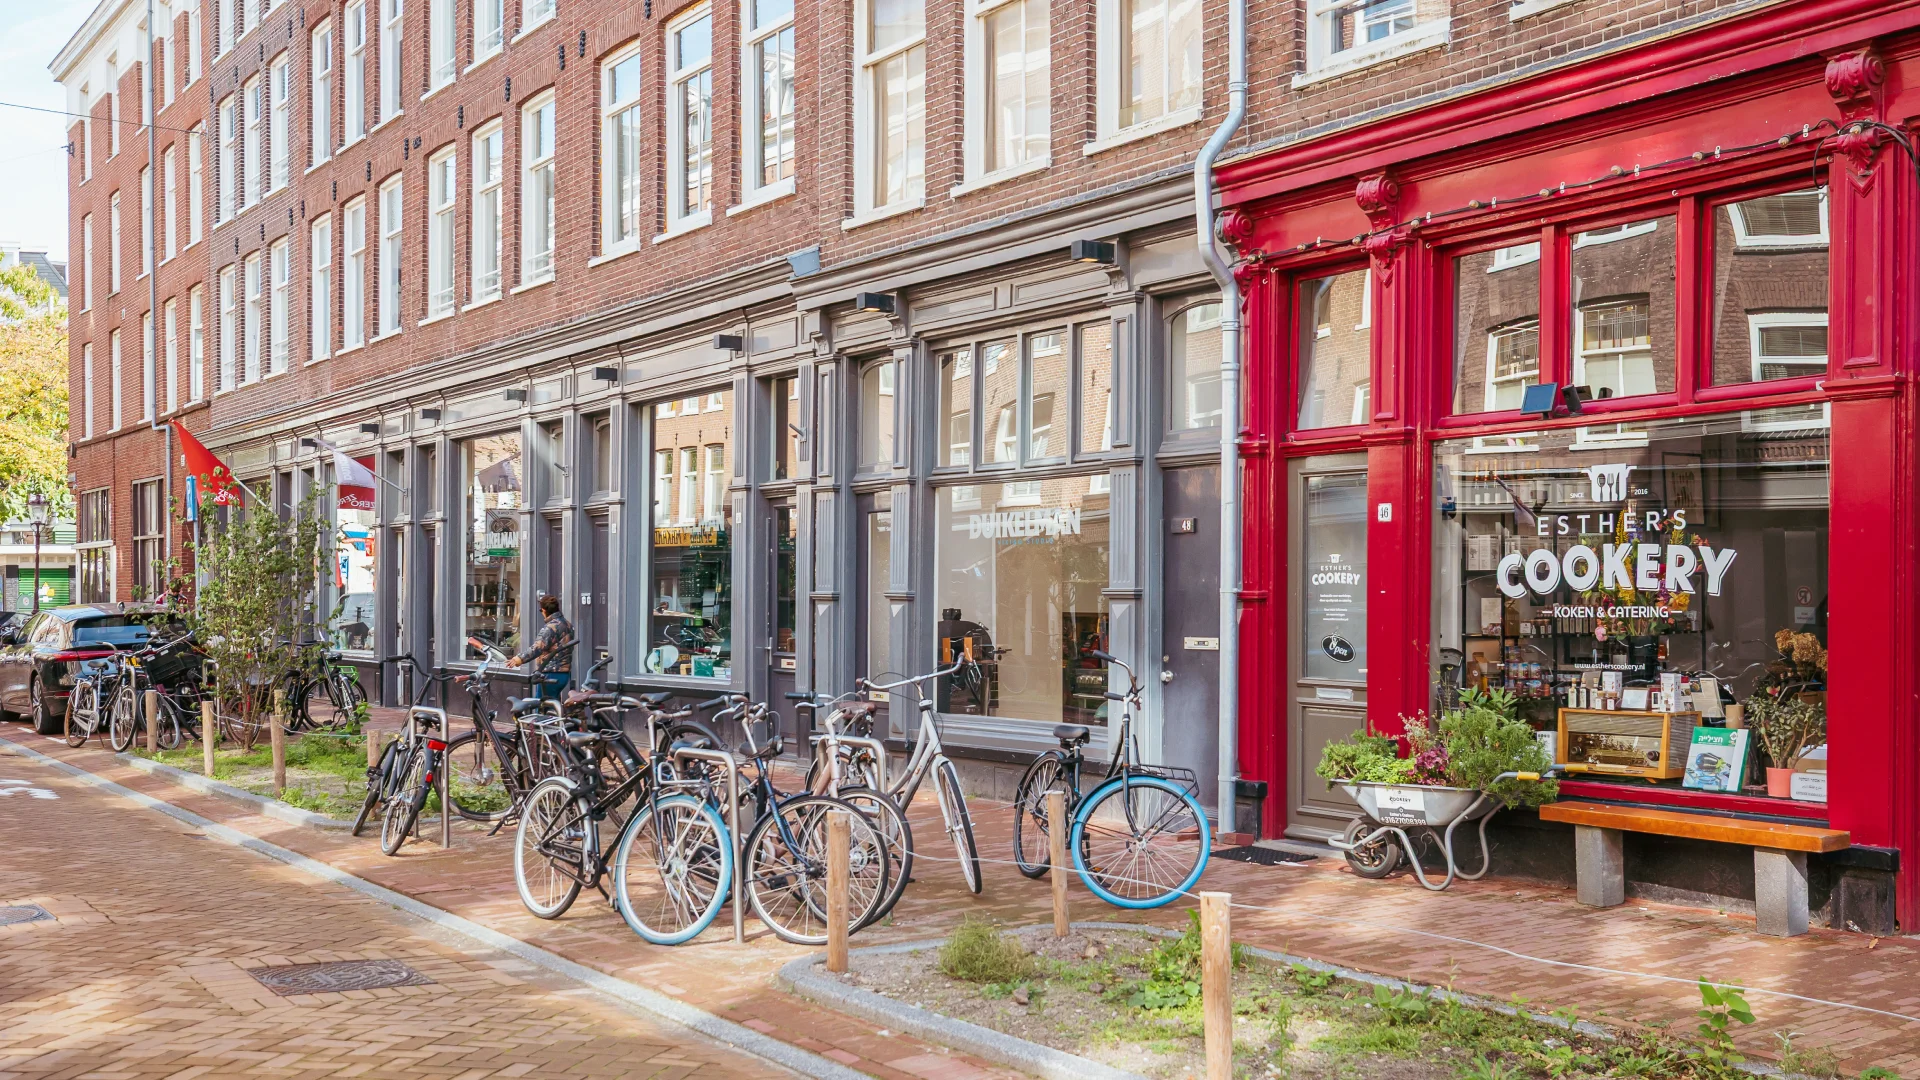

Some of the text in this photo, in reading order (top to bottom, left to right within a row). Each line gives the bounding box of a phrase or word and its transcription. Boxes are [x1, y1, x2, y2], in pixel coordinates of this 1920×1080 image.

[1379, 506, 1389, 519] 46
[969, 508, 1081, 540] DUIKELMAN
[1181, 520, 1191, 531] 48
[1537, 508, 1686, 536] ESTHER'S
[1497, 543, 1738, 599] COOKERY
[1311, 572, 1360, 586] COOKERY
[1554, 606, 1669, 618] KOKEN & CATERING
[1329, 640, 1348, 656] Open
[1574, 662, 1646, 672] www.estherscookery.nl
